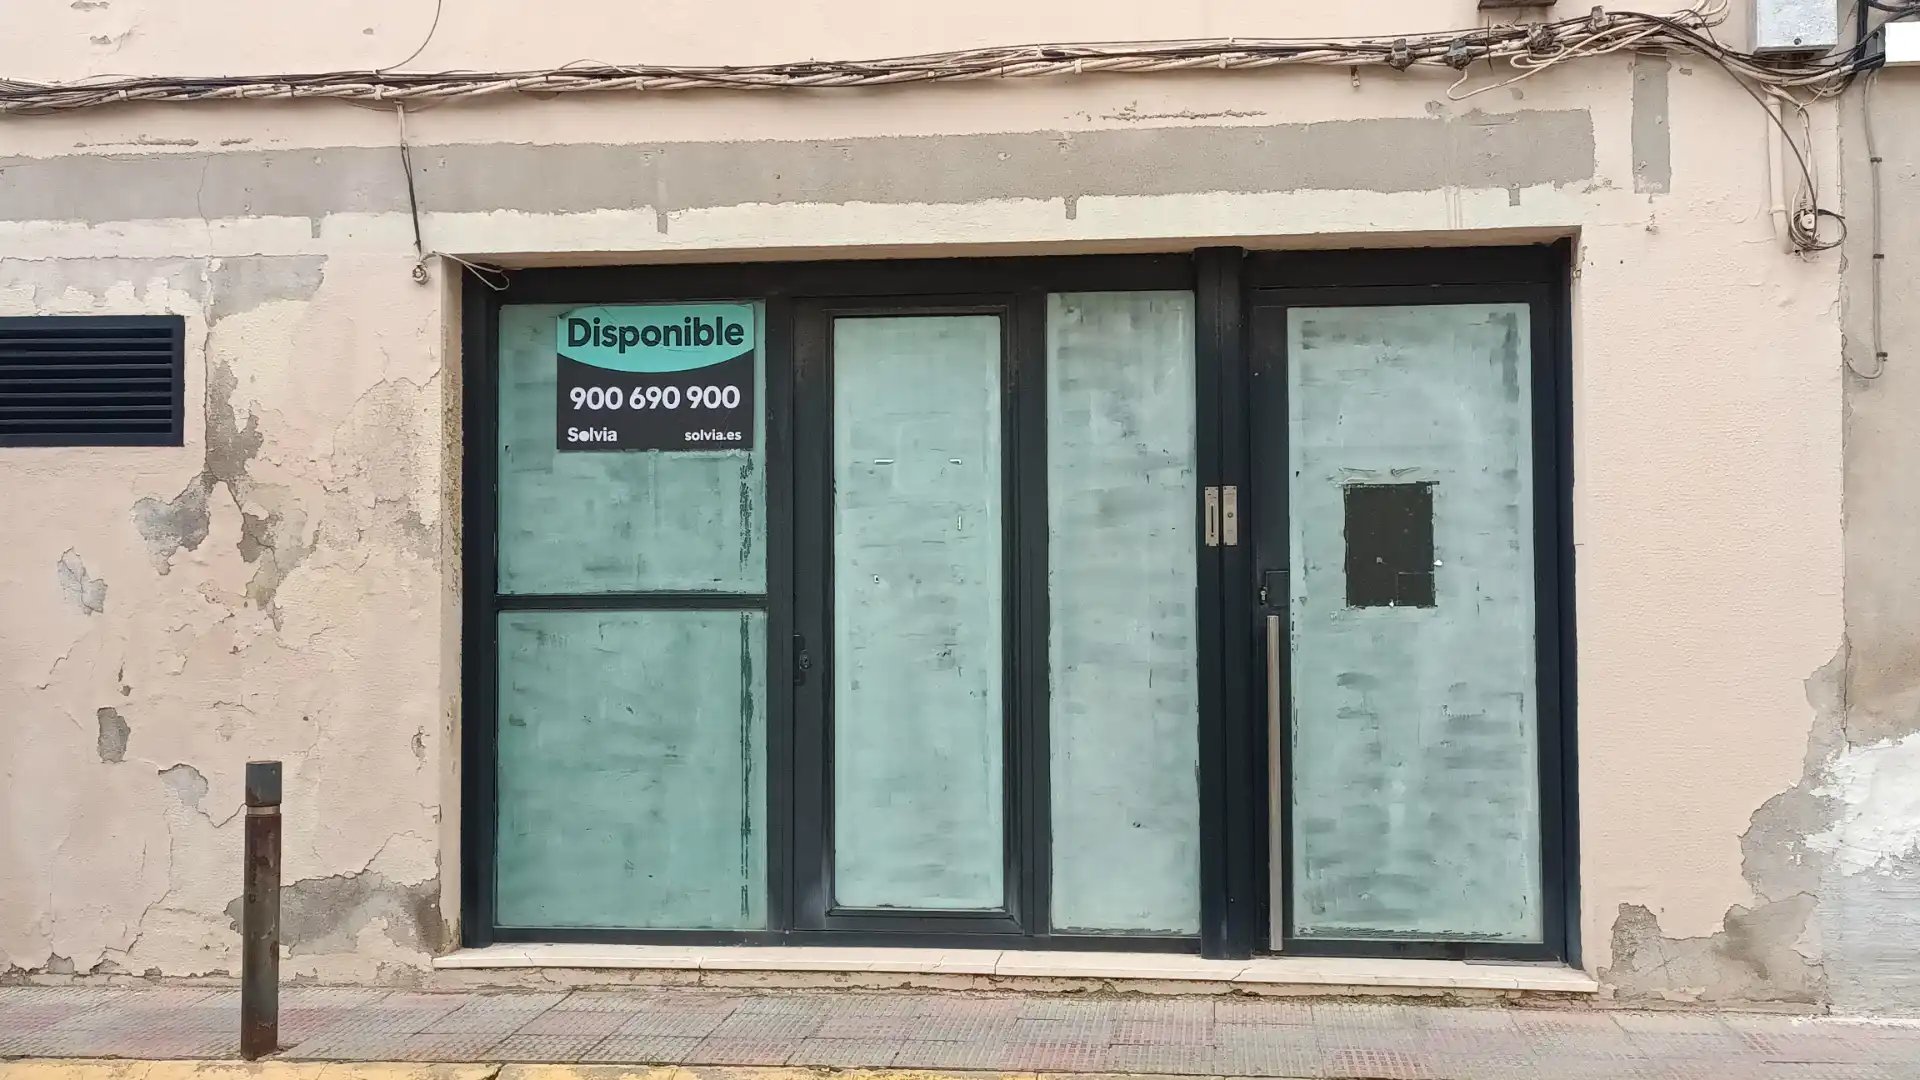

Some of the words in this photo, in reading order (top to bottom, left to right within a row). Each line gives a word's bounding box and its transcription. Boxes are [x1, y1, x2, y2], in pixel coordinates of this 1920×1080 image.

[568, 316, 744, 354] Disponible
[570, 386, 623, 410] 900
[629, 386, 681, 410] 690
[686, 385, 741, 409] 900
[567, 427, 618, 442] Solvia
[684, 429, 742, 441] solvia.es
